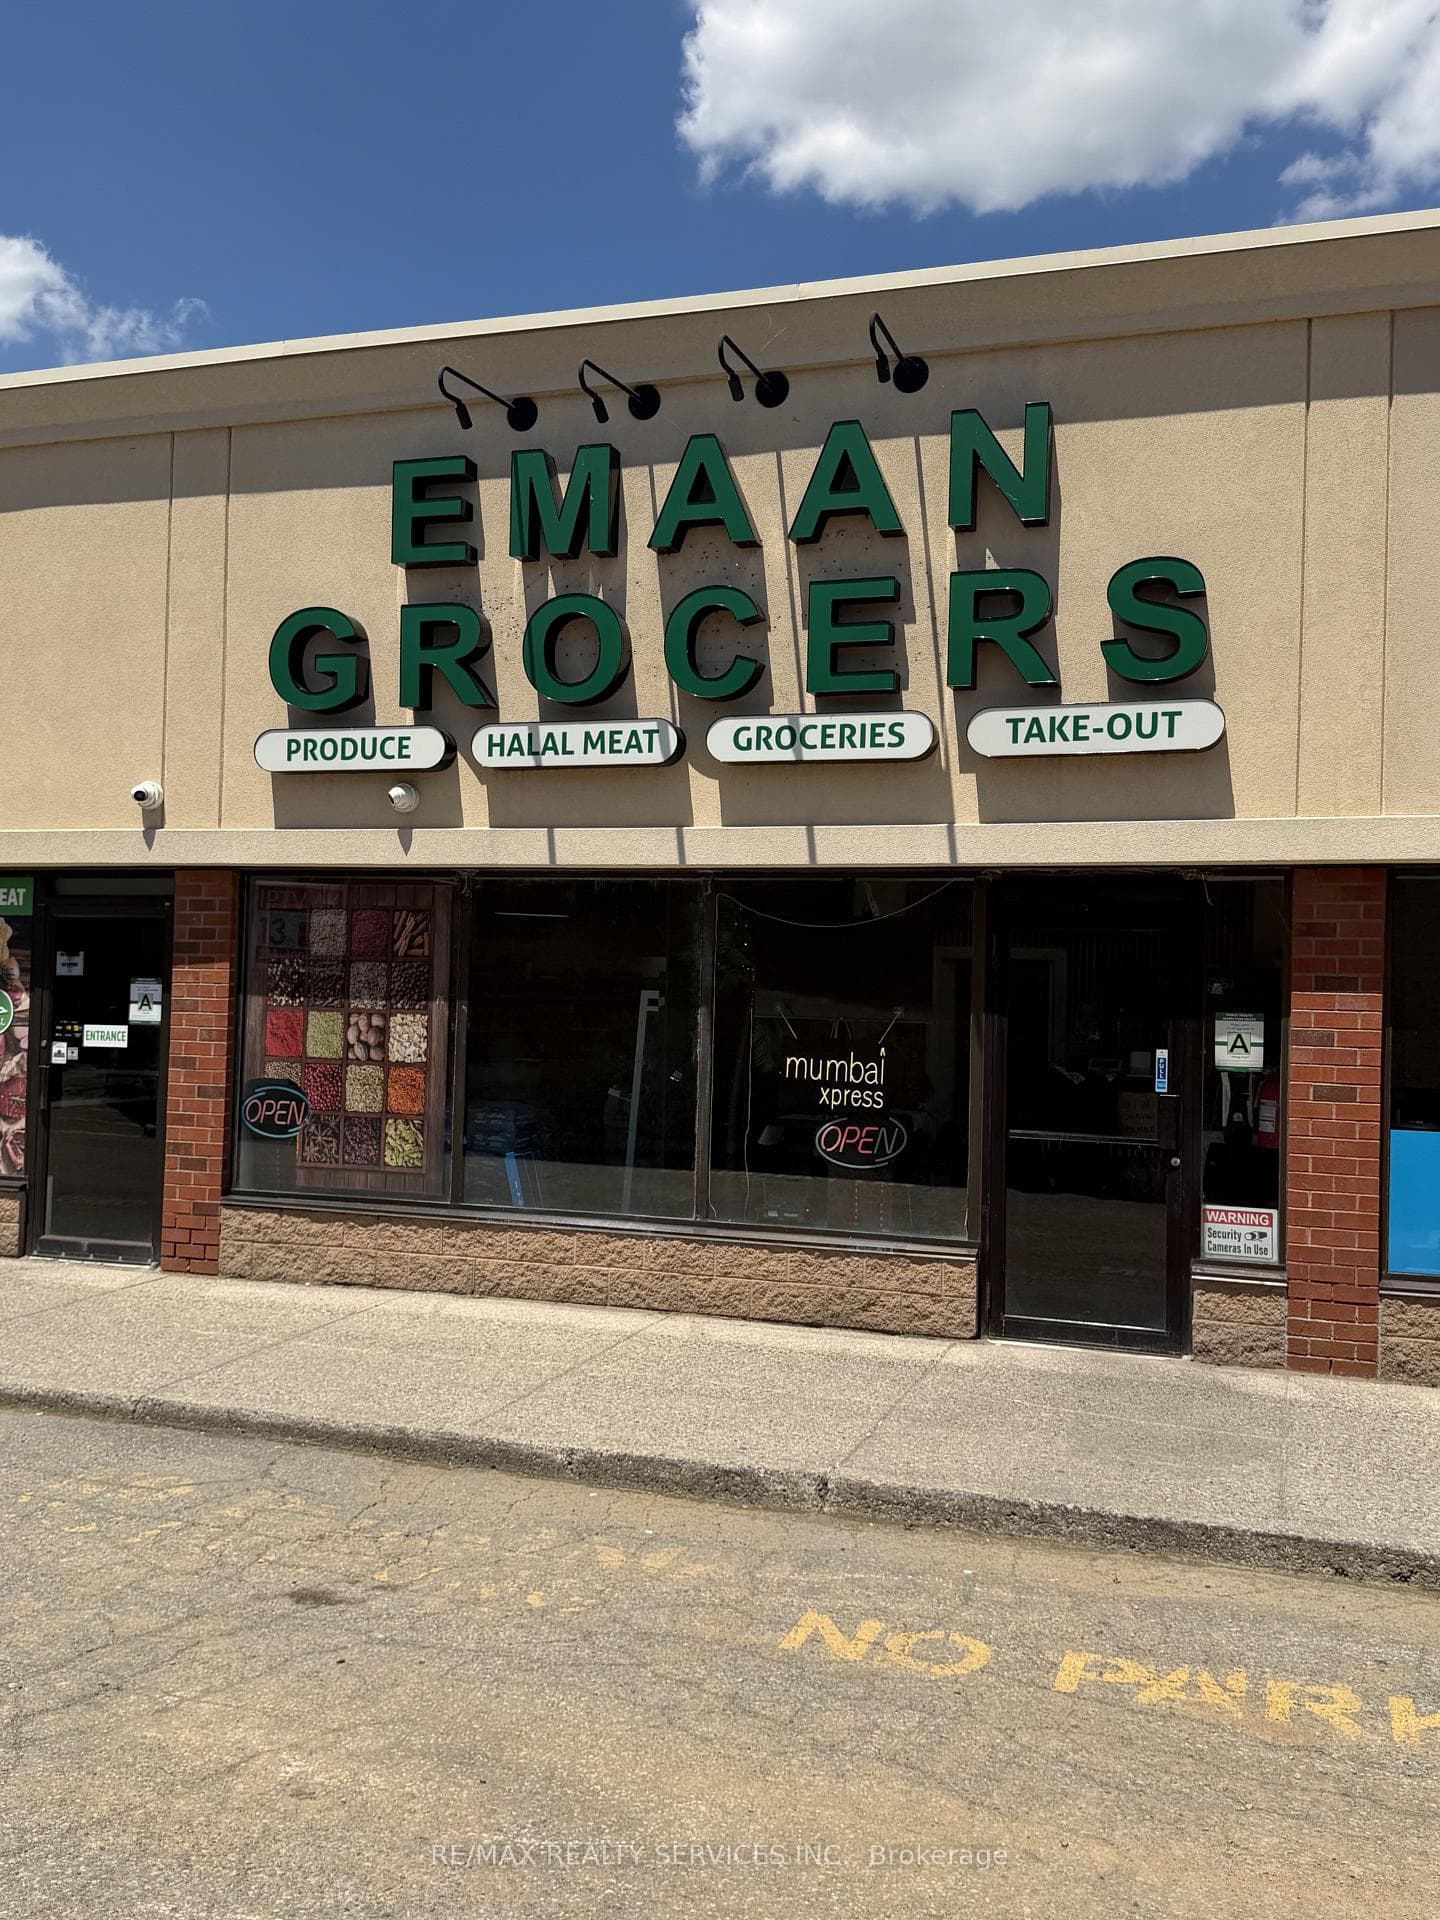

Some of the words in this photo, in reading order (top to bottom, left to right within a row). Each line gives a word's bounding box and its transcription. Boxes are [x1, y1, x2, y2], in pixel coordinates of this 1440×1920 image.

[391, 401, 1052, 567] EMAAN
[269, 556, 1209, 713] GROCERS
[733, 722, 906, 751] GROCERIES
[1005, 711, 1183, 745] TAKE-OUT
[286, 736, 411, 762] PRODUCE
[487, 732, 575, 758] HALAL
[583, 729, 660, 755] MEAT
[139, 993, 152, 1010] A
[86, 1031, 126, 1041] ENTRANCE
[1229, 1033, 1249, 1053] A
[786, 1047, 886, 1085] mumbai
[819, 1087, 884, 1110] xpress
[245, 1100, 306, 1126] OPEN
[820, 1126, 899, 1154] OPEN
[1206, 1210, 1270, 1226] WARNING
[1207, 1227, 1242, 1242] Security
[1207, 1240, 1242, 1254] Cameras
[1244, 1243, 1252, 1255] In
[1254, 1243, 1269, 1256] Use
[779, 1608, 992, 1676] NO
